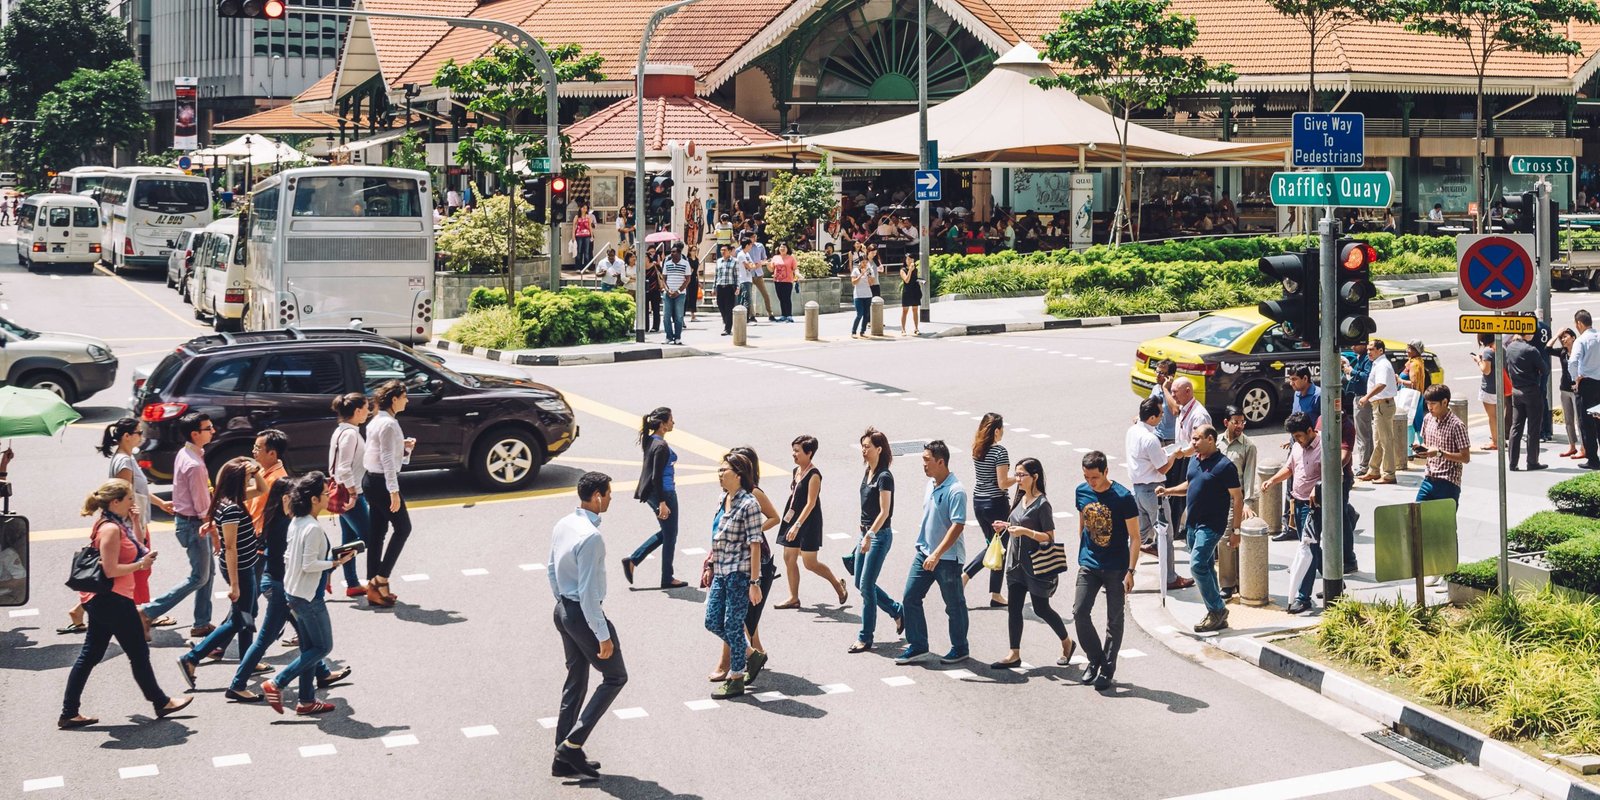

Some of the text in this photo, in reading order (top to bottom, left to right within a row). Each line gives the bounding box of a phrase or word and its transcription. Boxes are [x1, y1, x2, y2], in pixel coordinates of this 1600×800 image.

[1304, 116, 1352, 134] Give Way
[1323, 133, 1334, 147] To
[1295, 149, 1362, 163] Pedestrians
[1517, 158, 1569, 172] Cross St
[1278, 177, 1381, 203] Raffles Quay
[155, 214, 185, 225] AZ BUS
[1463, 319, 1493, 330] 7.00am
[1503, 319, 1534, 332] 7.00pm
